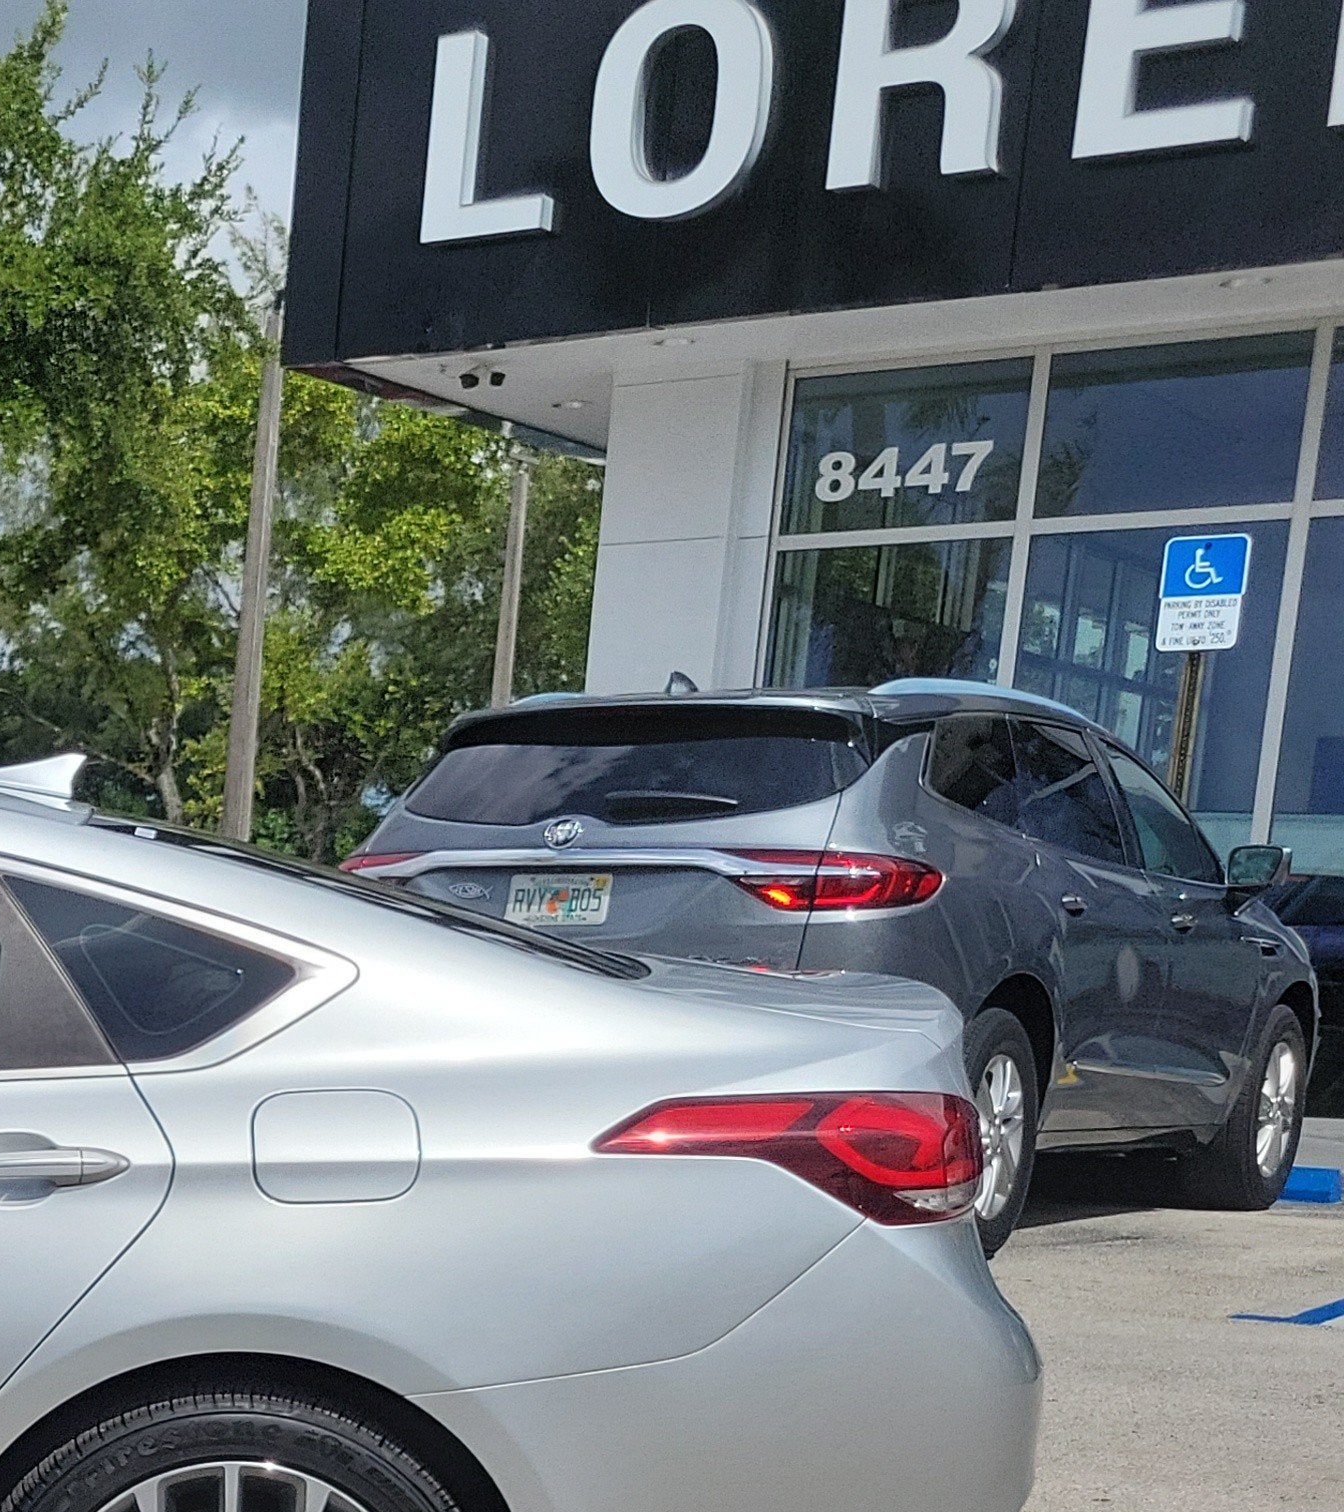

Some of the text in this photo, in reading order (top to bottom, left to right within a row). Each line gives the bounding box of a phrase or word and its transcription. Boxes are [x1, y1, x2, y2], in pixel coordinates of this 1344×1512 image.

[419, 0, 1344, 244] LORE
[815, 440, 994, 502] 8447
[1164, 598, 1238, 610] PARKING BY DISABLED
[1177, 609, 1221, 619] PERMIT ONLY
[1171, 620, 1226, 631] TOW AWAY ZONE
[512, 887, 547, 914] RVY
